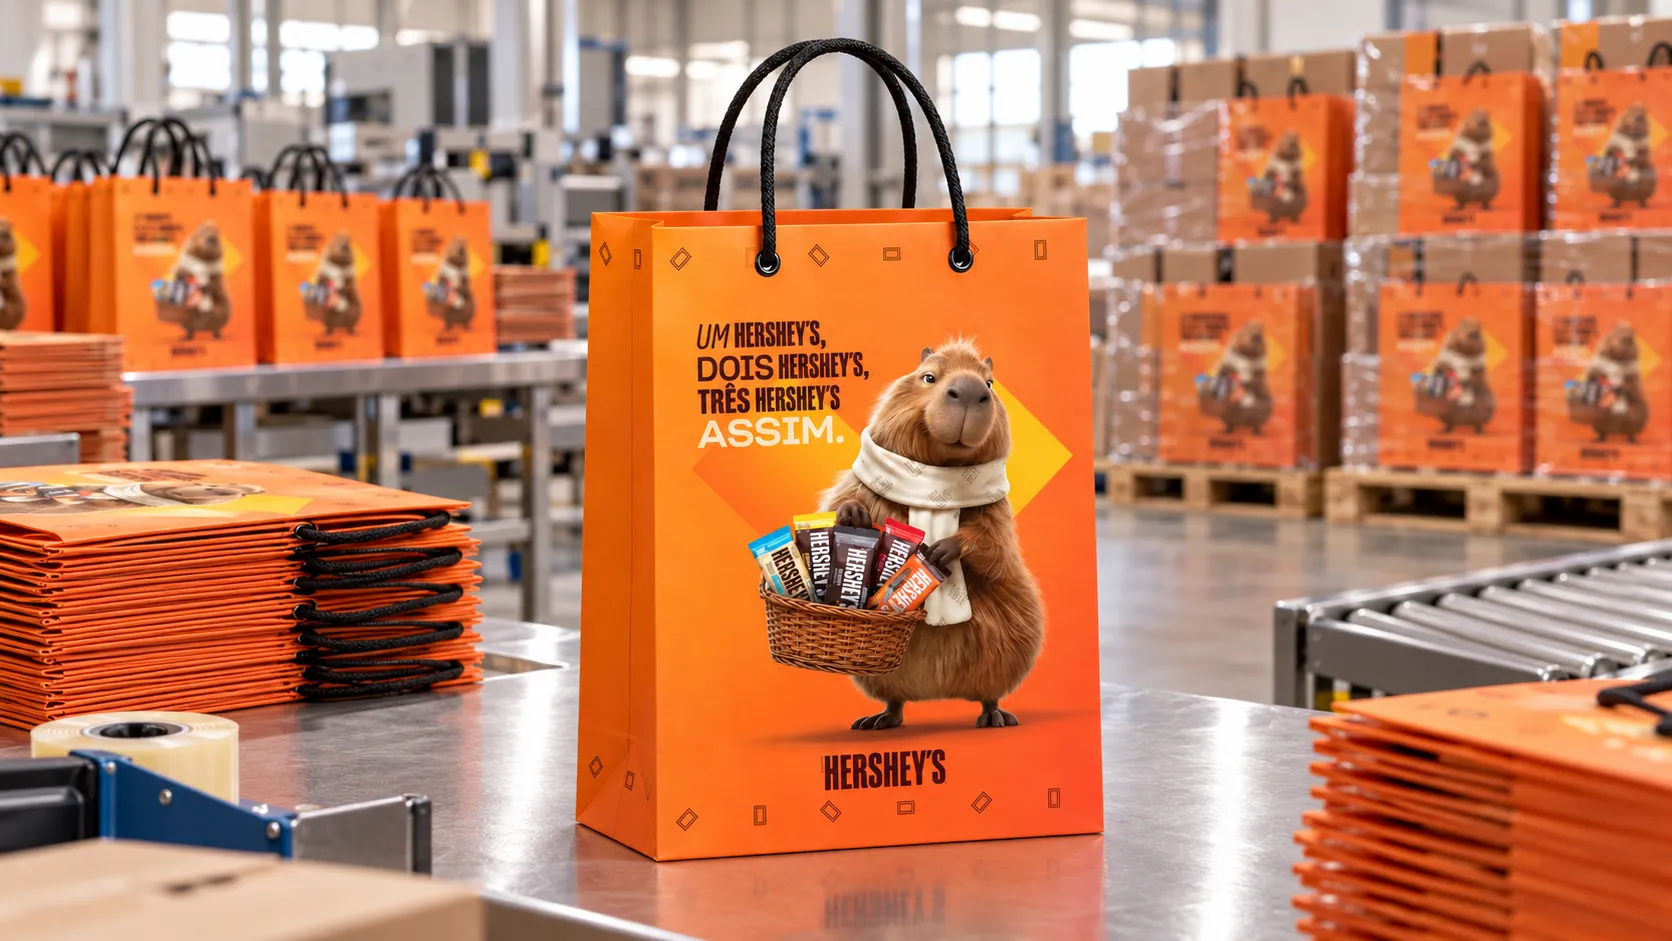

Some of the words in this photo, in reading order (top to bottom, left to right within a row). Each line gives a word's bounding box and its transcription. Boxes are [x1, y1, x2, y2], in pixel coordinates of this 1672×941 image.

[696, 323, 730, 350] UM
[734, 320, 827, 349] HERSHEY'S,
[697, 354, 774, 382] DOIS
[778, 351, 869, 380] HERSHEY'S,
[697, 382, 751, 415] TRÊS
[755, 384, 841, 413] HERSHEY'S
[697, 415, 845, 449] ASSIM.
[824, 749, 947, 791] HERSHEY'S
